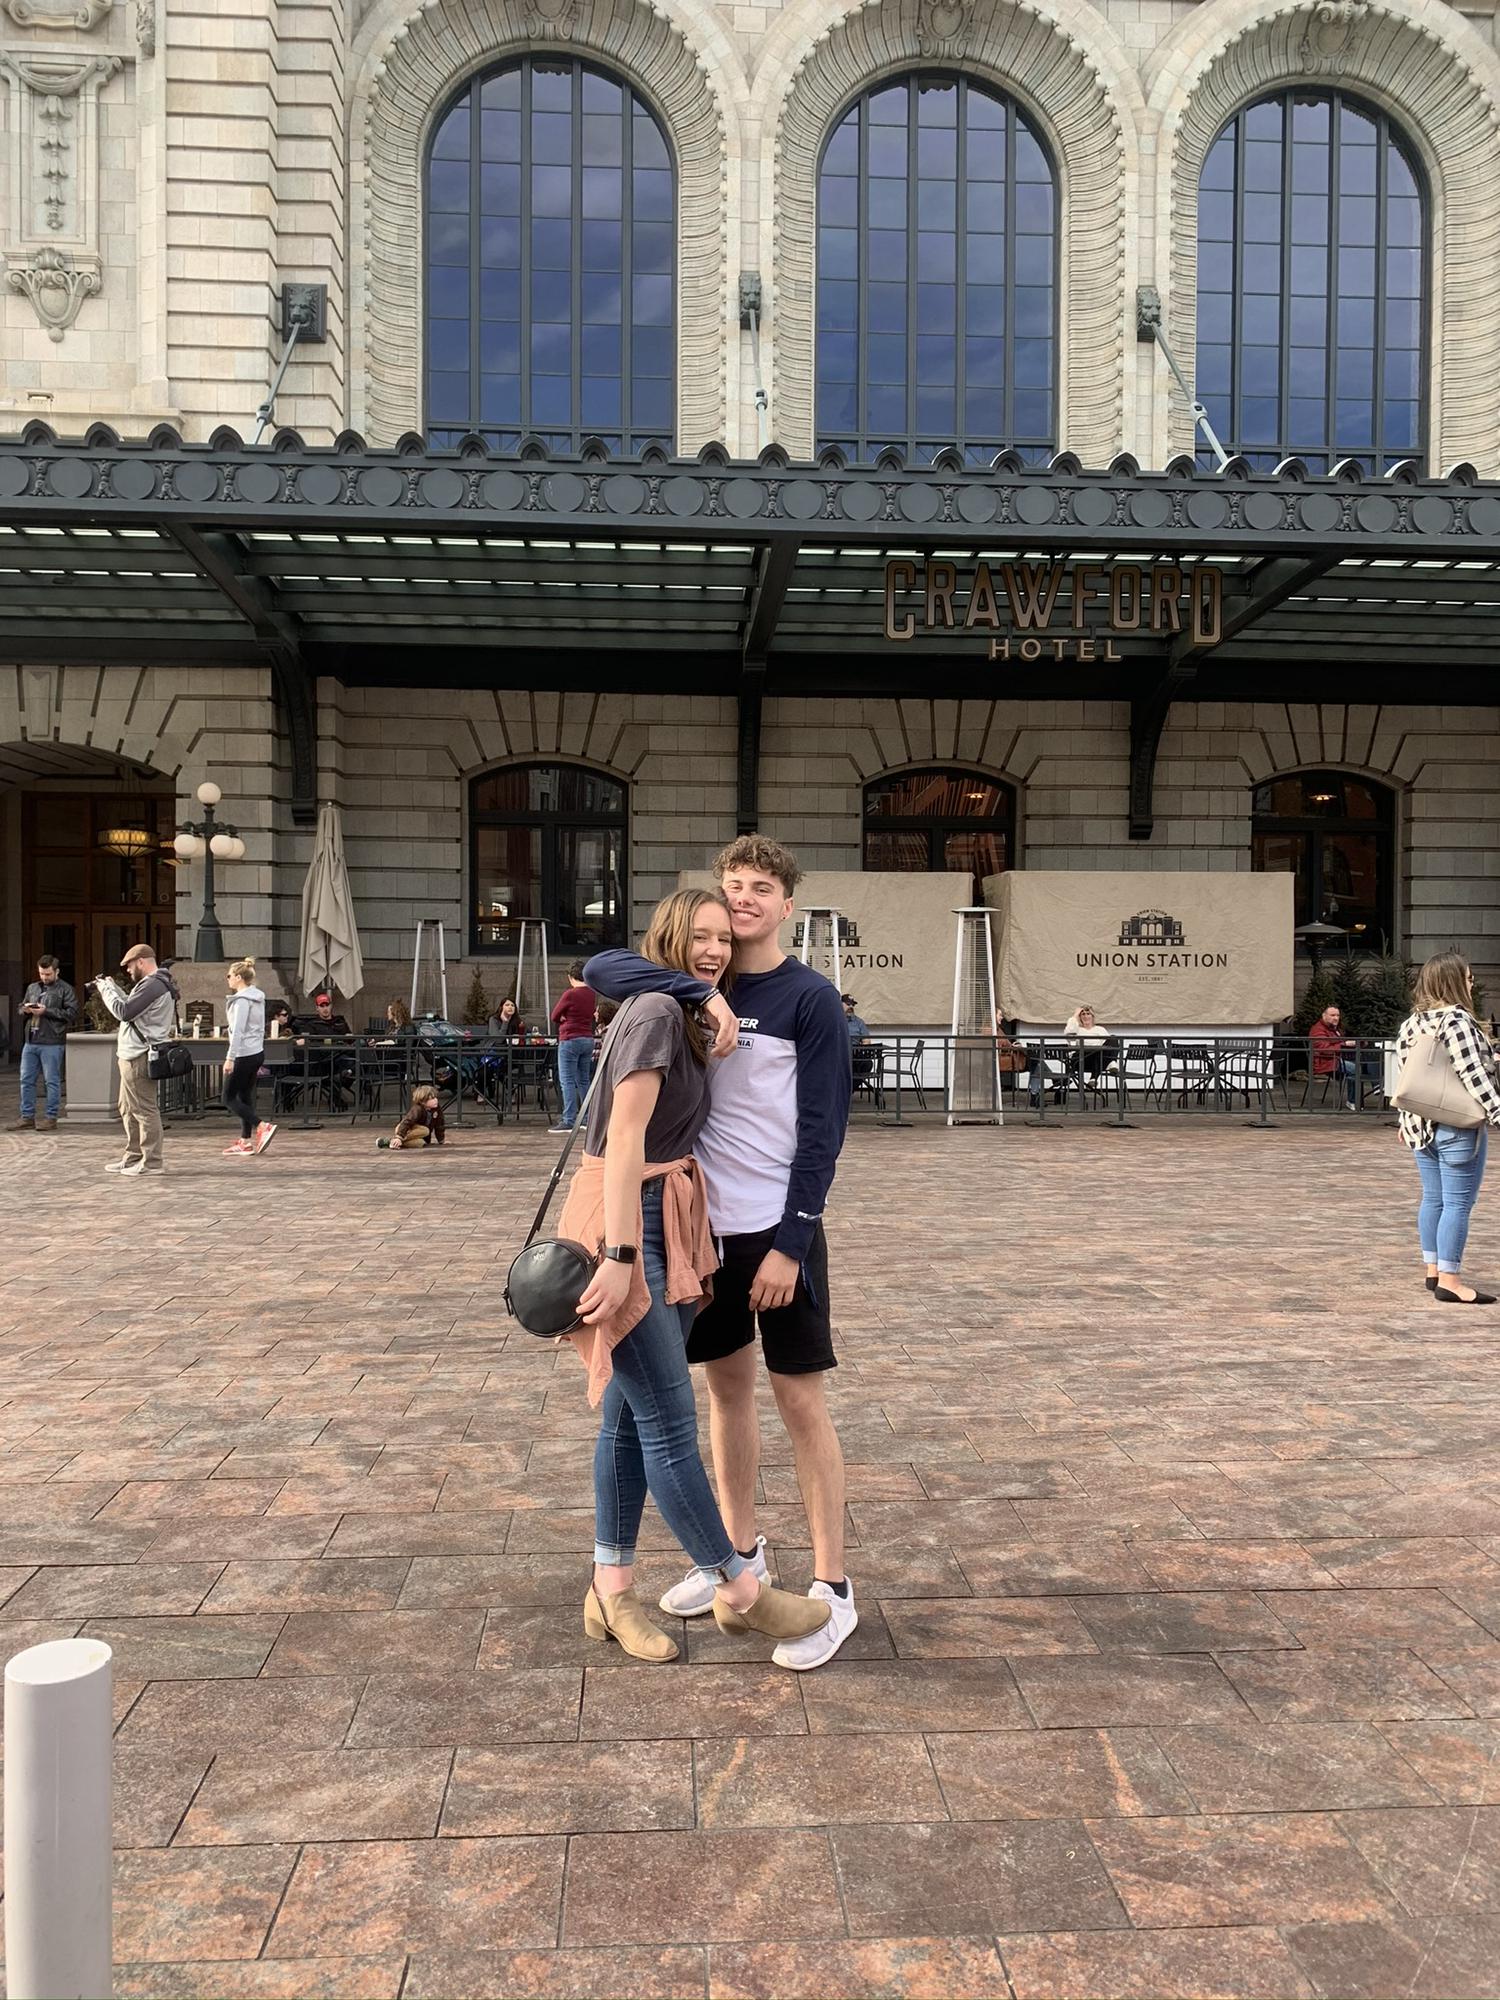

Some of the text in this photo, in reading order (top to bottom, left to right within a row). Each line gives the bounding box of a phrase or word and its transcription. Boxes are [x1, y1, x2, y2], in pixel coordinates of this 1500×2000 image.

[885, 559, 1224, 646] CRAWFORD
[988, 638, 1124, 662] HOTEL
[1076, 953, 1228, 968] UNION STATION
